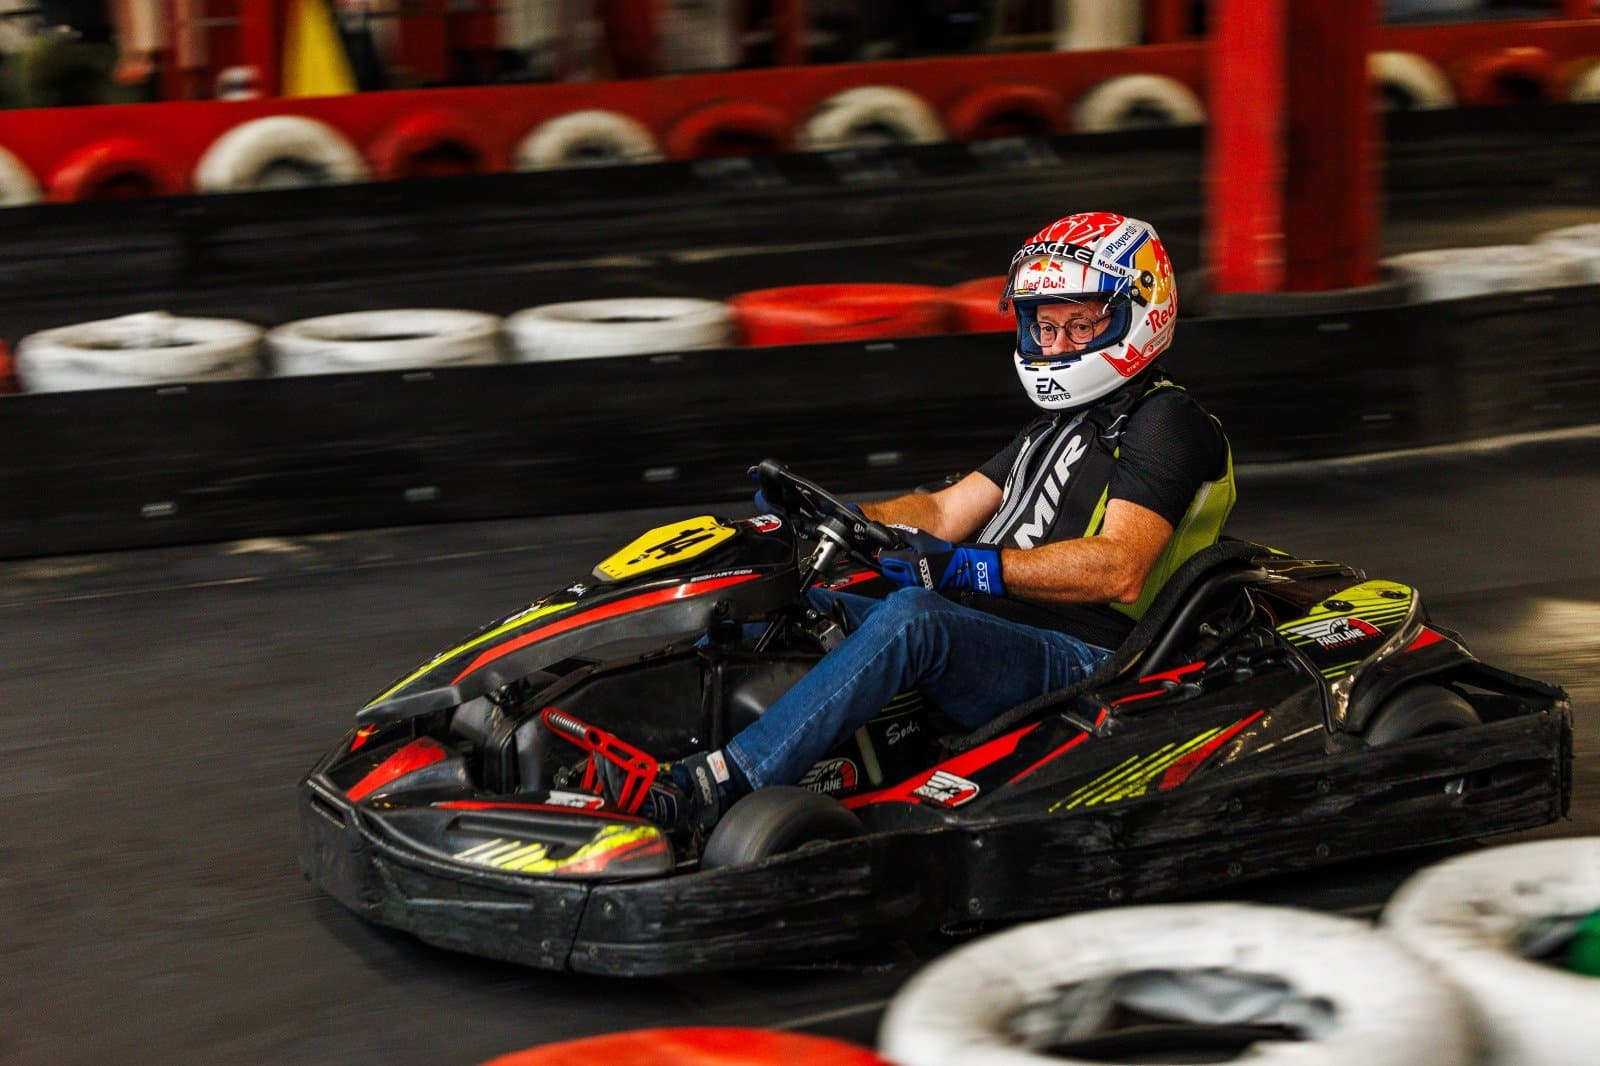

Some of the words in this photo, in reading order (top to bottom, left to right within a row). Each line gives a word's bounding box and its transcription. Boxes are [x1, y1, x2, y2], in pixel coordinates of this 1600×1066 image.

[1106, 231, 1131, 254] Player
[1011, 243, 1093, 264] ORACLE
[1098, 259, 1118, 272] Mobil
[1023, 276, 1041, 289] Red
[1043, 276, 1066, 289] Bull
[1148, 292, 1175, 334] Red
[1036, 377, 1067, 394] EA
[1037, 392, 1071, 401] SPORTS
[976, 561, 989, 592] arco
[1316, 628, 1366, 647] FASTLANE
